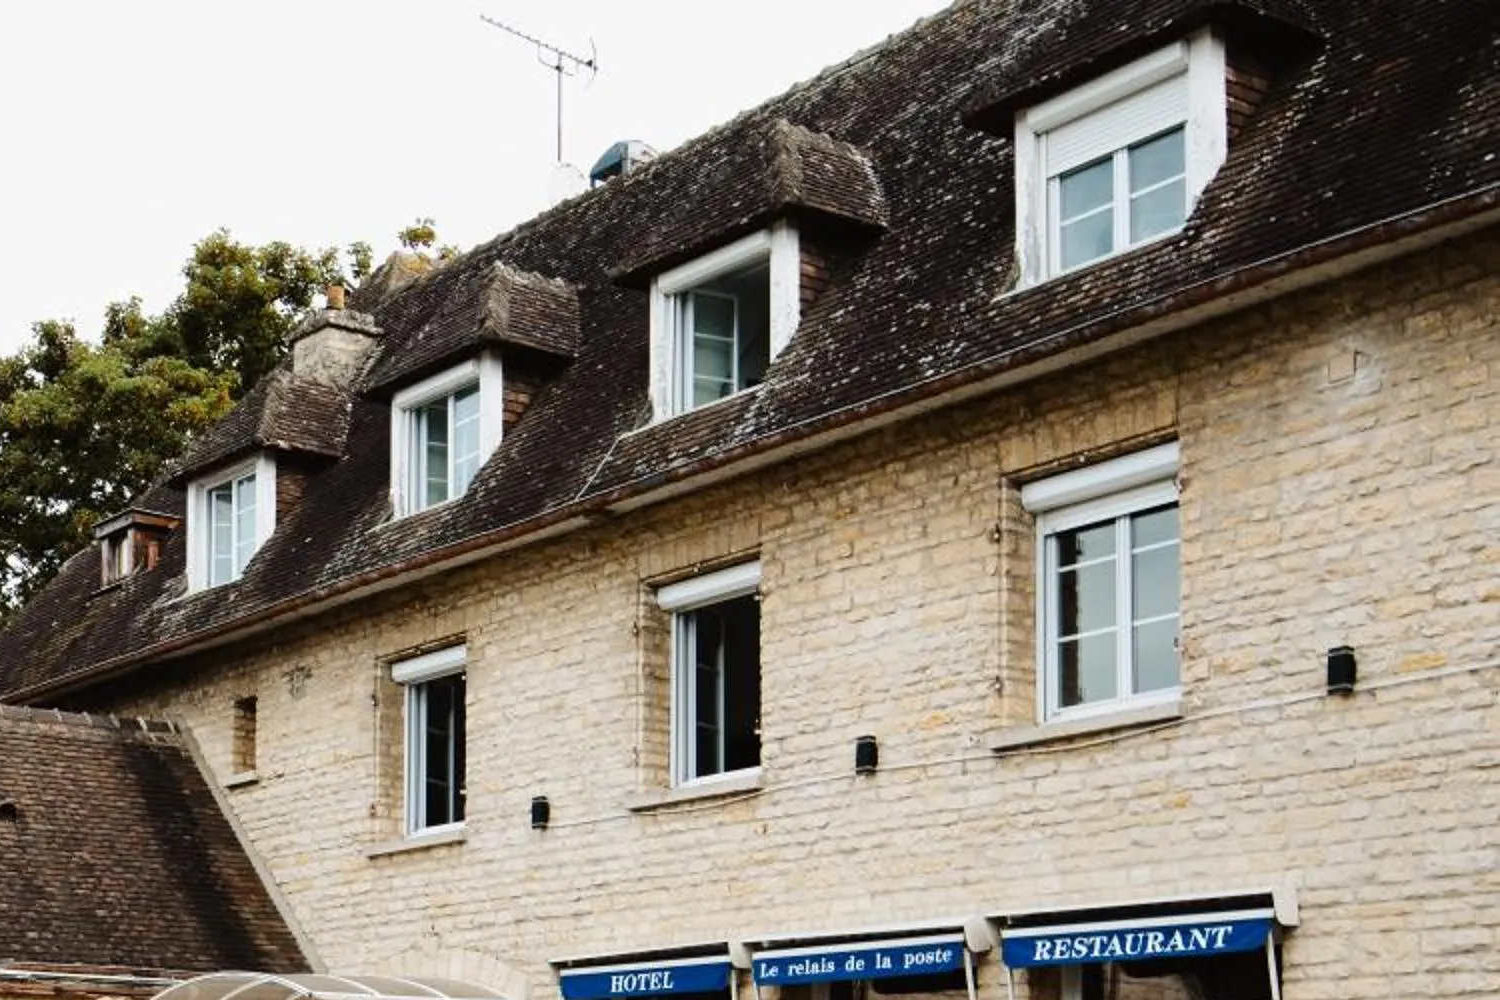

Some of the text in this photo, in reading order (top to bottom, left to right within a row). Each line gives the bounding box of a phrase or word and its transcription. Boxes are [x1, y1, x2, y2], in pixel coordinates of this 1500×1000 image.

[1033, 925, 1233, 961] RESTAURANT
[759, 948, 953, 978] Le relais de la poste
[610, 971, 674, 993] HOTEL
